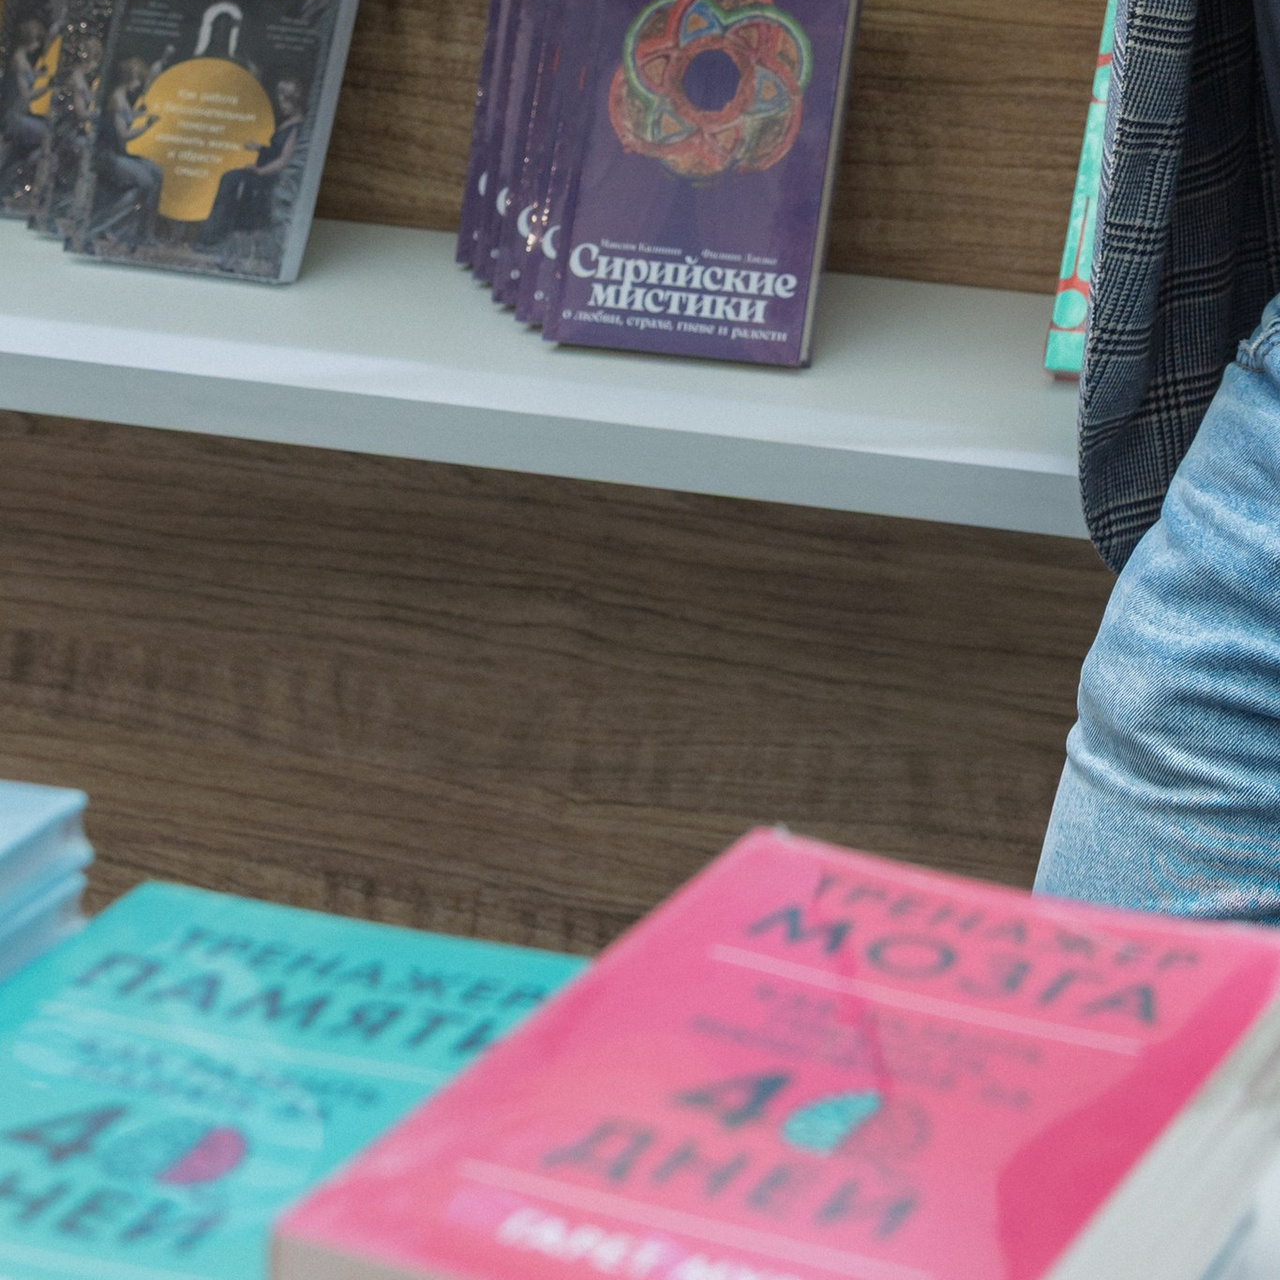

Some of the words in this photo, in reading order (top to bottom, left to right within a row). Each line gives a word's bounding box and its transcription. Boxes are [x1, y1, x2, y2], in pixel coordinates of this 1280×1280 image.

[569, 242, 798, 299] Сирийские
[588, 282, 768, 324] мистики
[562, 310, 571, 320] о
[718, 325, 729, 335] и
[731, 326, 788, 342] радости
[815, 870, 1202, 972] ТРЕНАЖЕР
[746, 904, 1160, 1028] МОЗГА
[540, 1120, 920, 1240] ДНЕЙ
